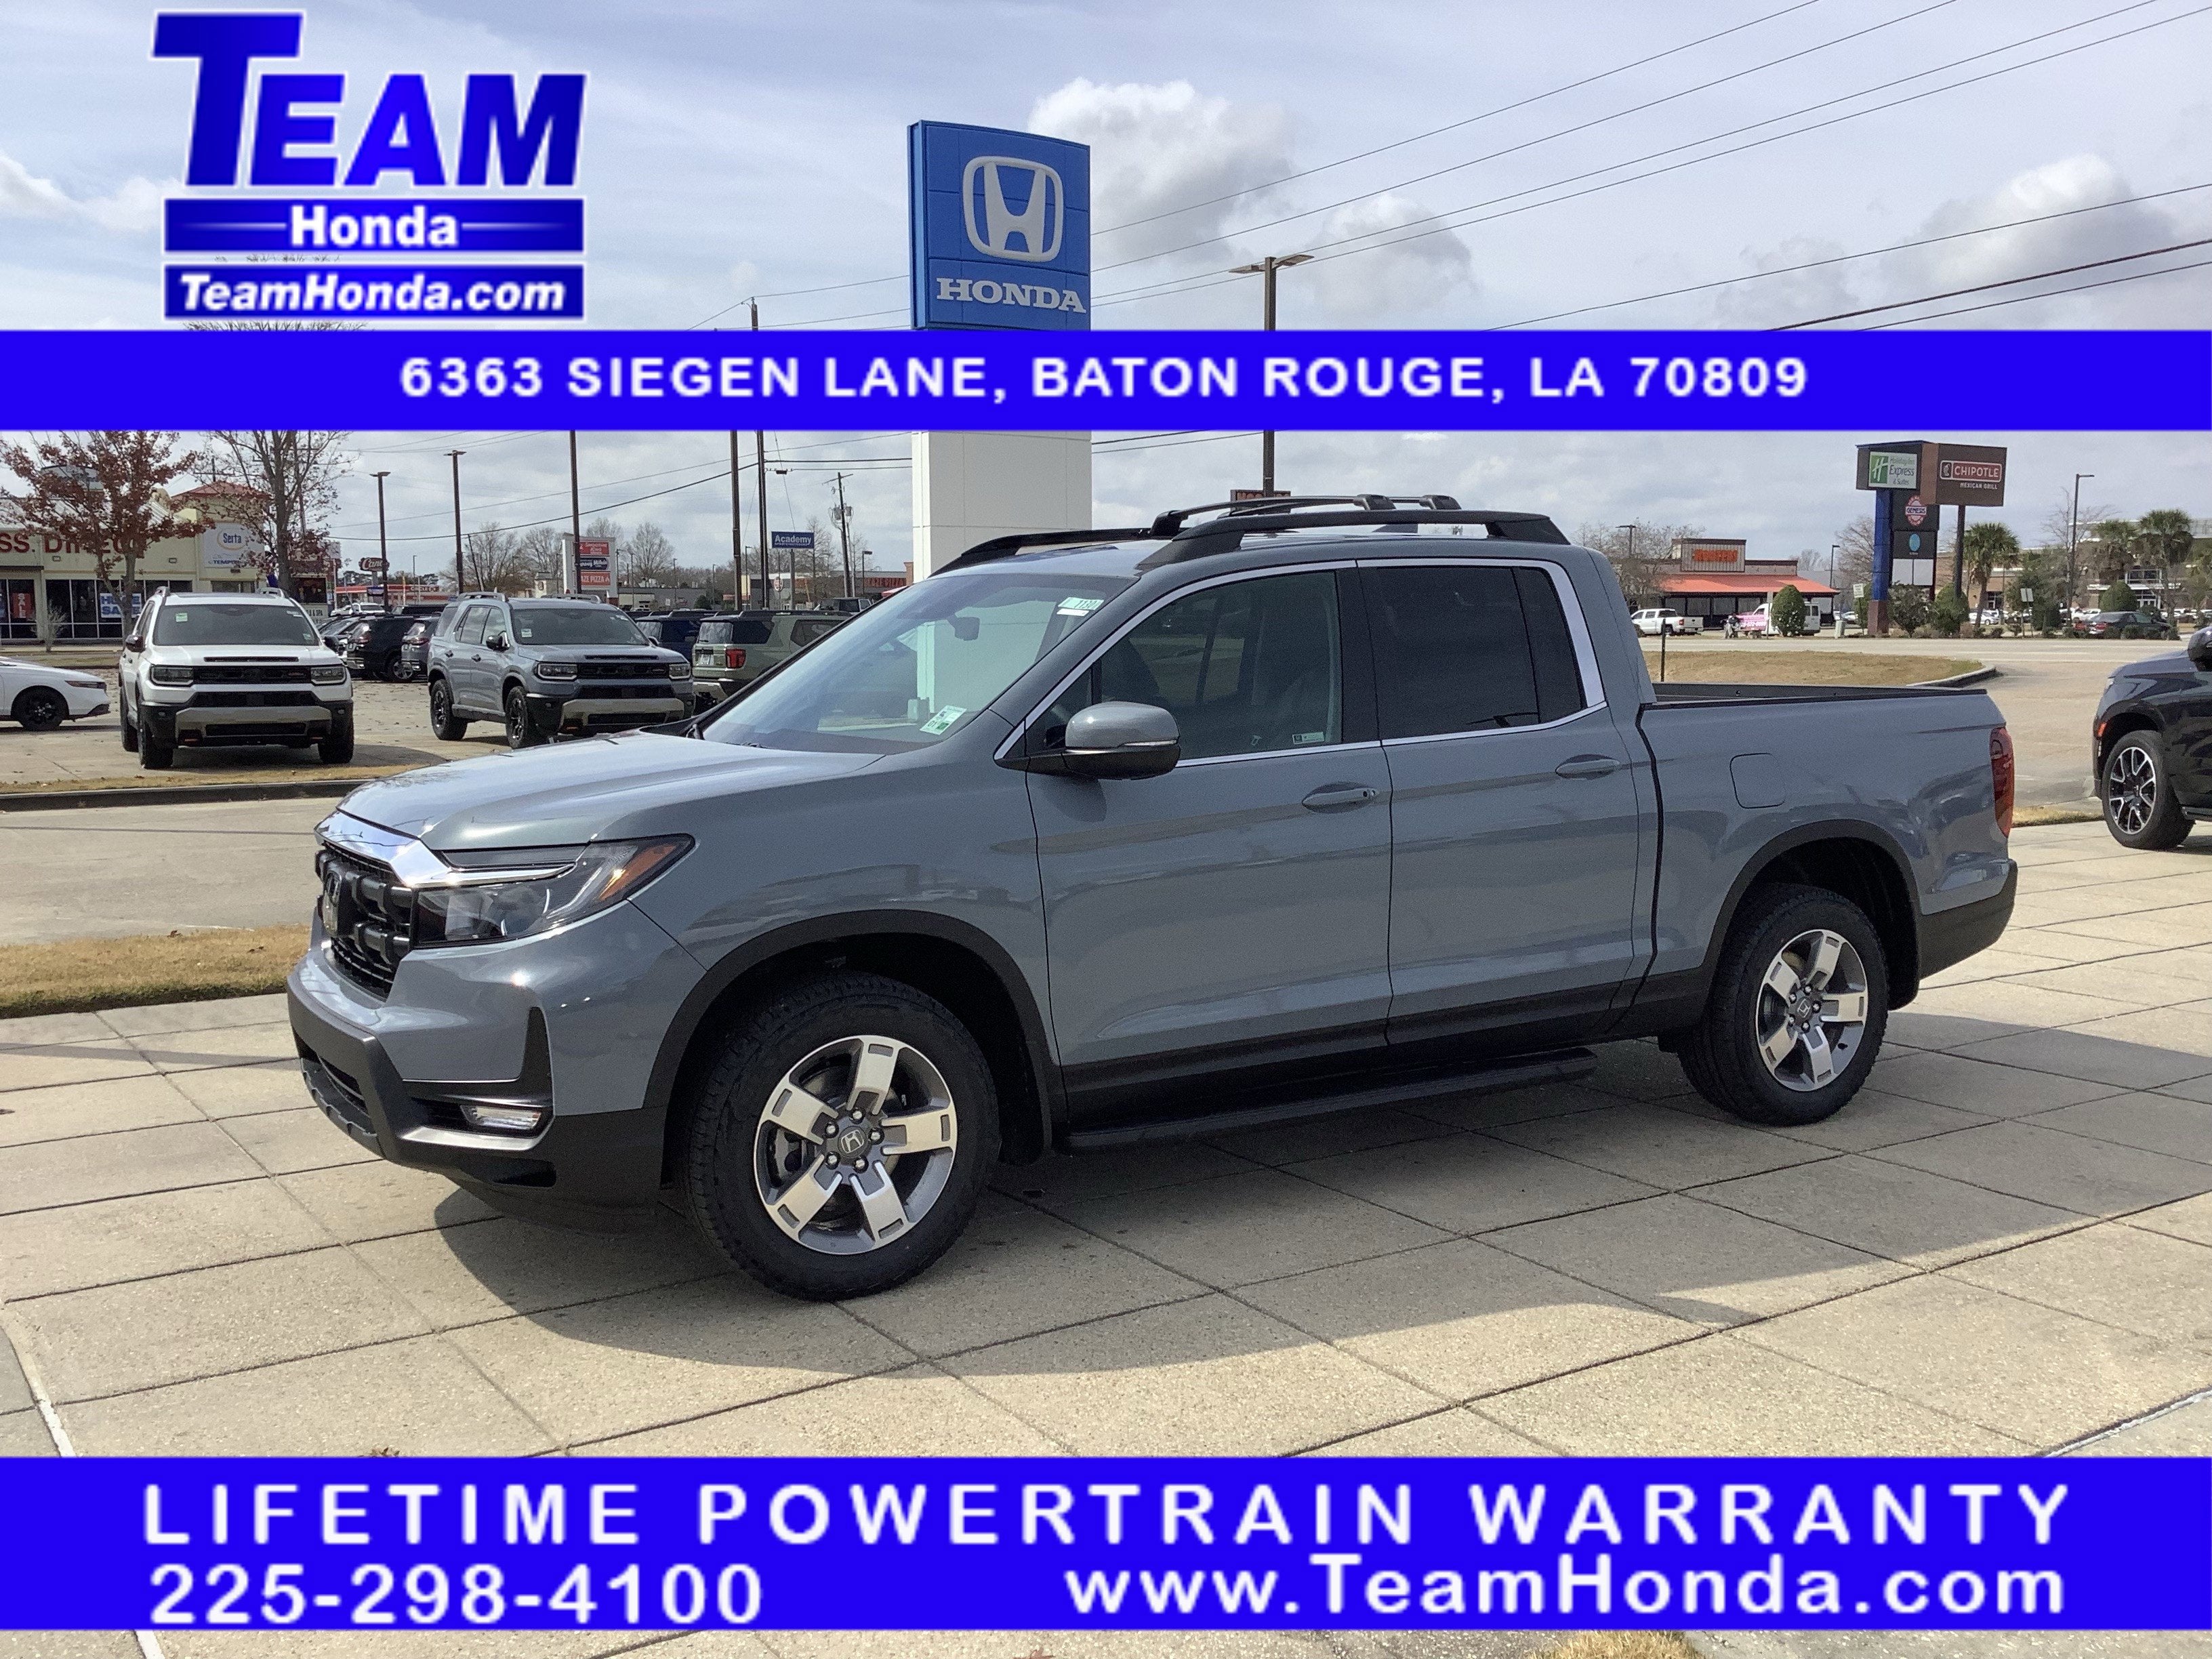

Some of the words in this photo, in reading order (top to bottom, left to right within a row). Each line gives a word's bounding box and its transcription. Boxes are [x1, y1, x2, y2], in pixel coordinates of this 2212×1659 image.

[937, 277, 1086, 313] HONDA
[1889, 465, 1914, 476] Express
[1954, 466, 1999, 478] CHIPOTLE
[223, 533, 241, 544] Serta
[775, 535, 811, 545] Academy
